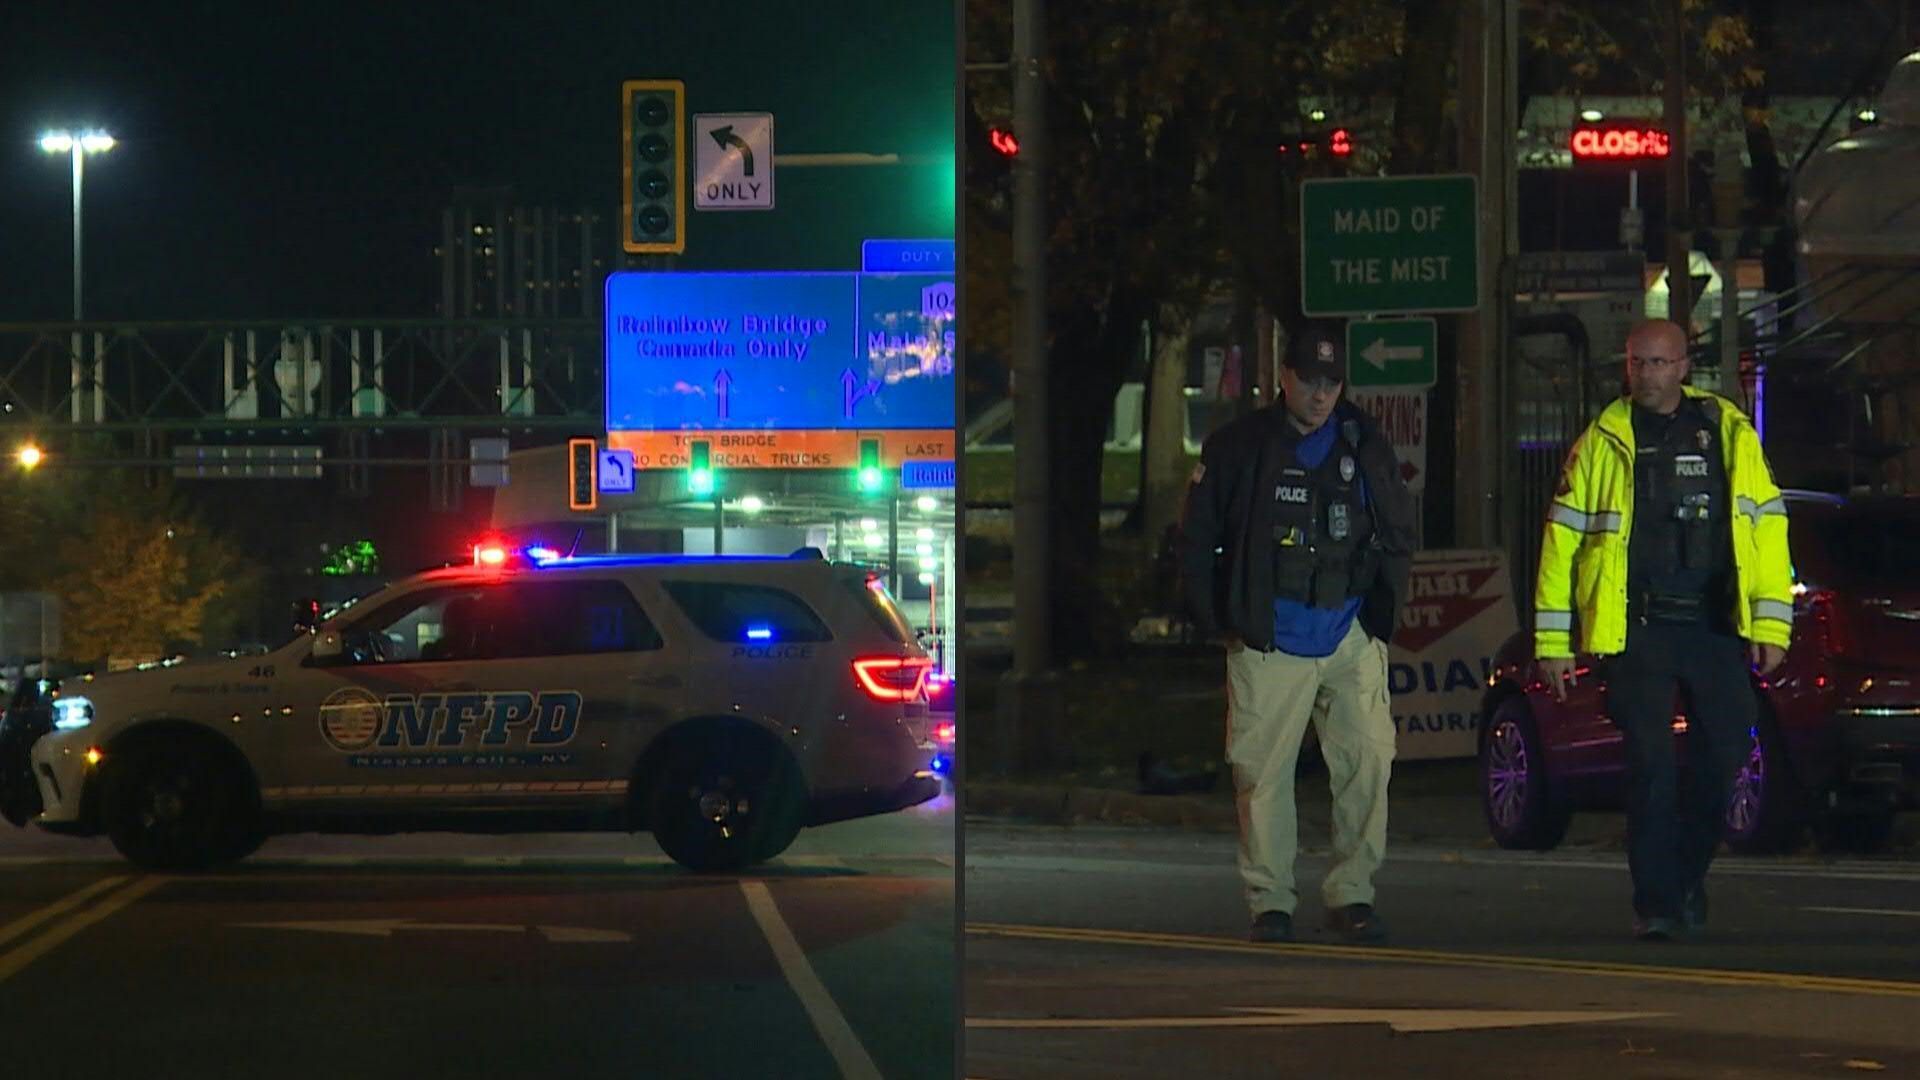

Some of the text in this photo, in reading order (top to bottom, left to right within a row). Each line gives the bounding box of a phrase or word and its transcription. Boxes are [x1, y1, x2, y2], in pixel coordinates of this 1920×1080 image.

[707, 183, 761, 200] ONLY
[1333, 206, 1445, 233] MAID OF
[902, 250, 943, 263] DUTY
[1330, 256, 1450, 284] THE MIST
[618, 315, 827, 338] Rainbow Bridge
[943, 331, 955, 350] S
[639, 340, 808, 362] Canada Only
[720, 434, 777, 447] BRIDGE
[905, 443, 944, 456] LAST
[771, 453, 832, 465] TRUCKS
[604, 478, 627, 487] ONLY
[1275, 485, 1308, 503] POLICE
[1408, 573, 1471, 600] JABI
[1402, 605, 1444, 628] UT
[732, 646, 814, 657] POLICE
[377, 691, 584, 750] NFPD
[355, 756, 449, 769] Niagara
[541, 754, 572, 765] NY
